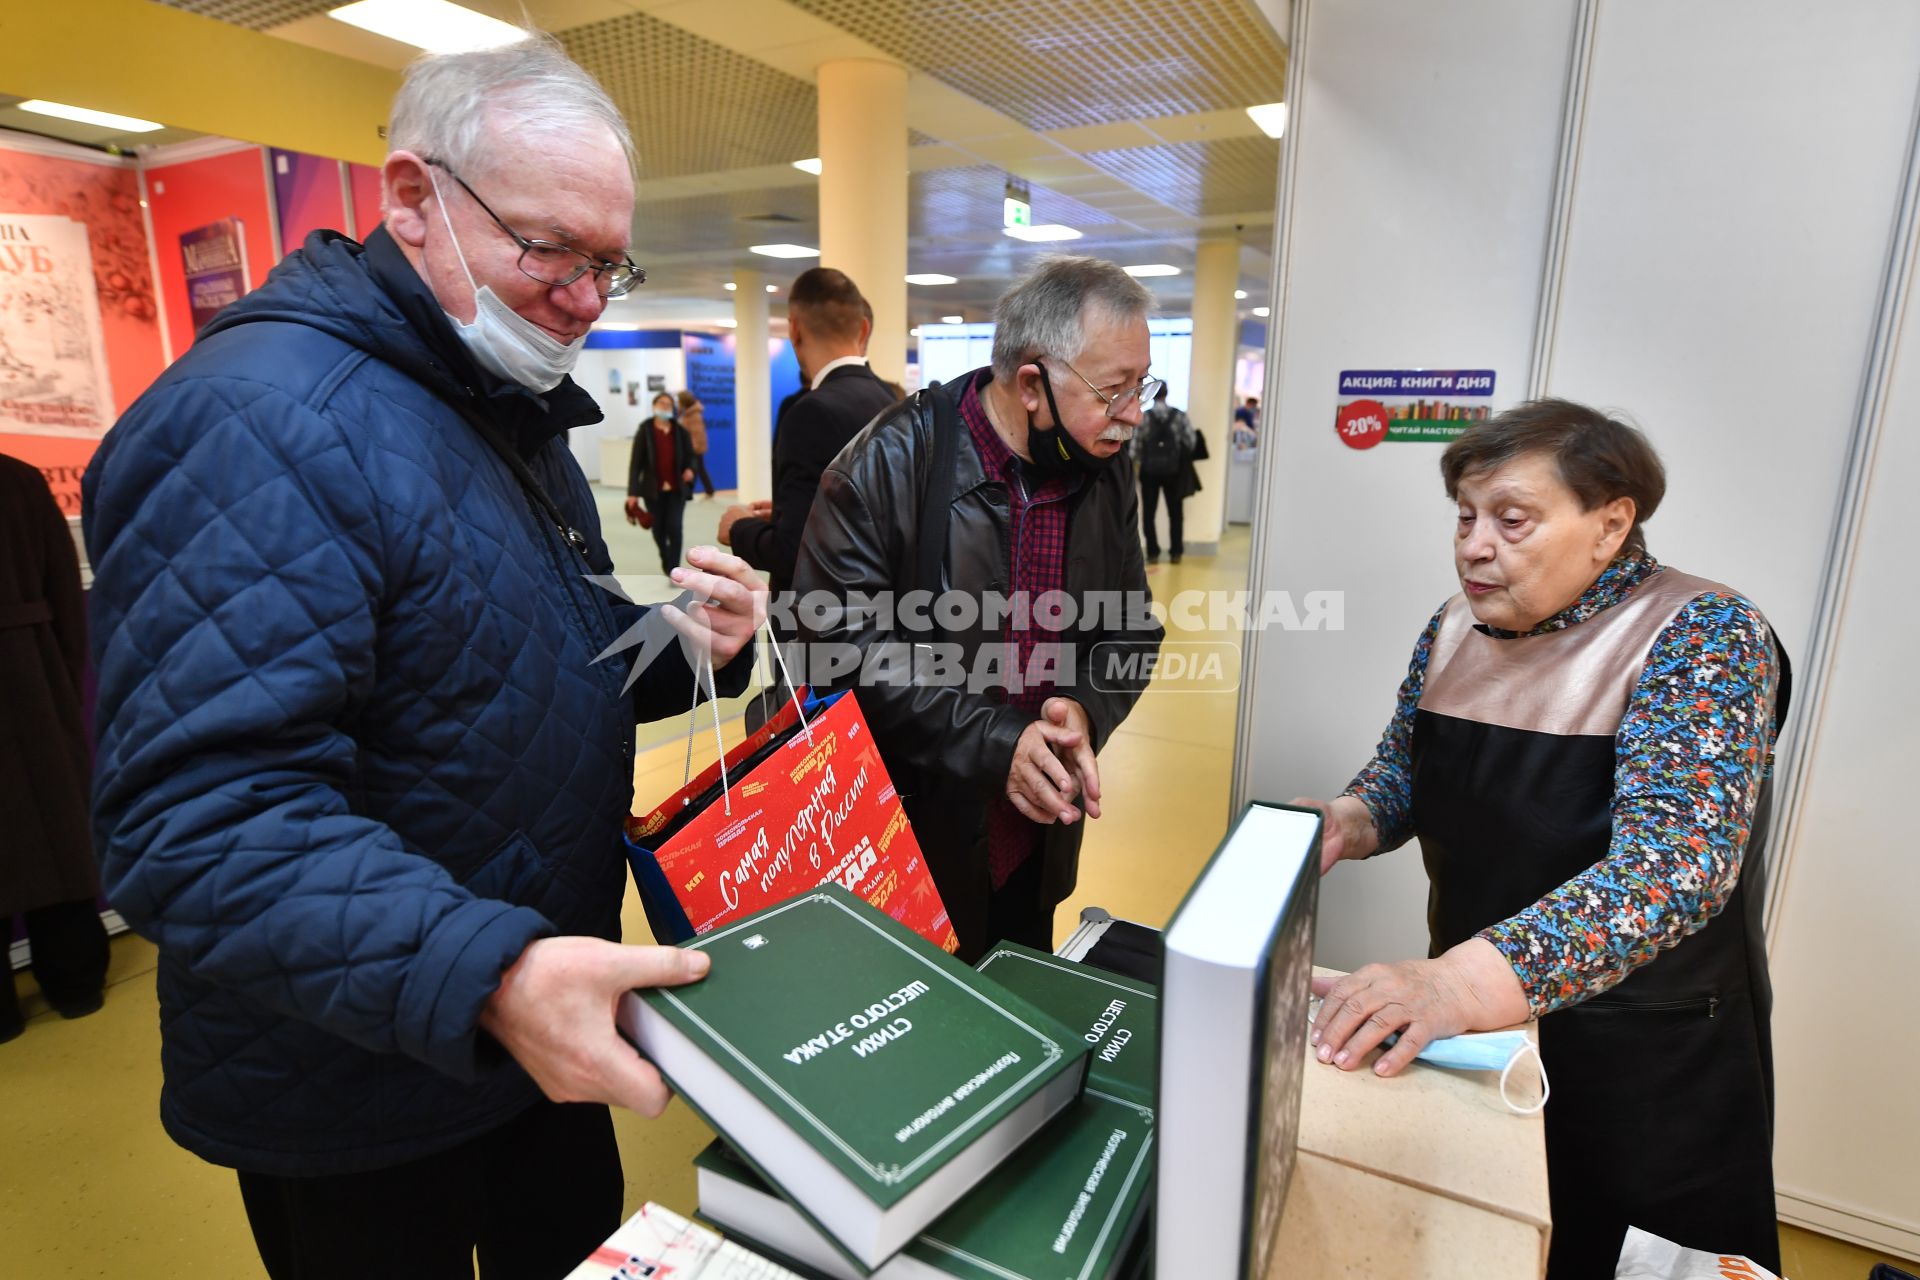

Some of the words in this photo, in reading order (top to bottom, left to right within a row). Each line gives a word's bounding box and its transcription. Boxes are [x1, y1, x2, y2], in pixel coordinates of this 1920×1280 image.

[1342, 376, 1397, 389] АКЦИЯ:
[1401, 376, 1452, 388] КНИГИ
[1456, 376, 1490, 389] ДНЯ
[1342, 415, 1382, 436] -20%
[760, 763, 837, 893] популярная
[809, 842, 821, 870] в
[820, 766, 869, 856] России
[684, 870, 705, 893] КП
[719, 827, 770, 910] Самая
[862, 870, 885, 894] РАДИО
[868, 868, 896, 904] ОМОЛЬСКАЯ
[694, 907, 731, 933] ОМОЛЬСКАЯ
[849, 979, 931, 1030] ШЕСТОГО
[1084, 999, 1127, 1044] ШЕСТОГО
[782, 1022, 855, 1065] ЭТАЖА
[850, 1017, 913, 1058] СТИХИ
[1098, 1028, 1133, 1063] СТИХИ
[952, 1050, 1021, 1101] Поэтическая
[894, 1094, 957, 1143] антология
[1084, 1128, 1128, 1194] Поэтическая
[1051, 1191, 1092, 1254] антология
